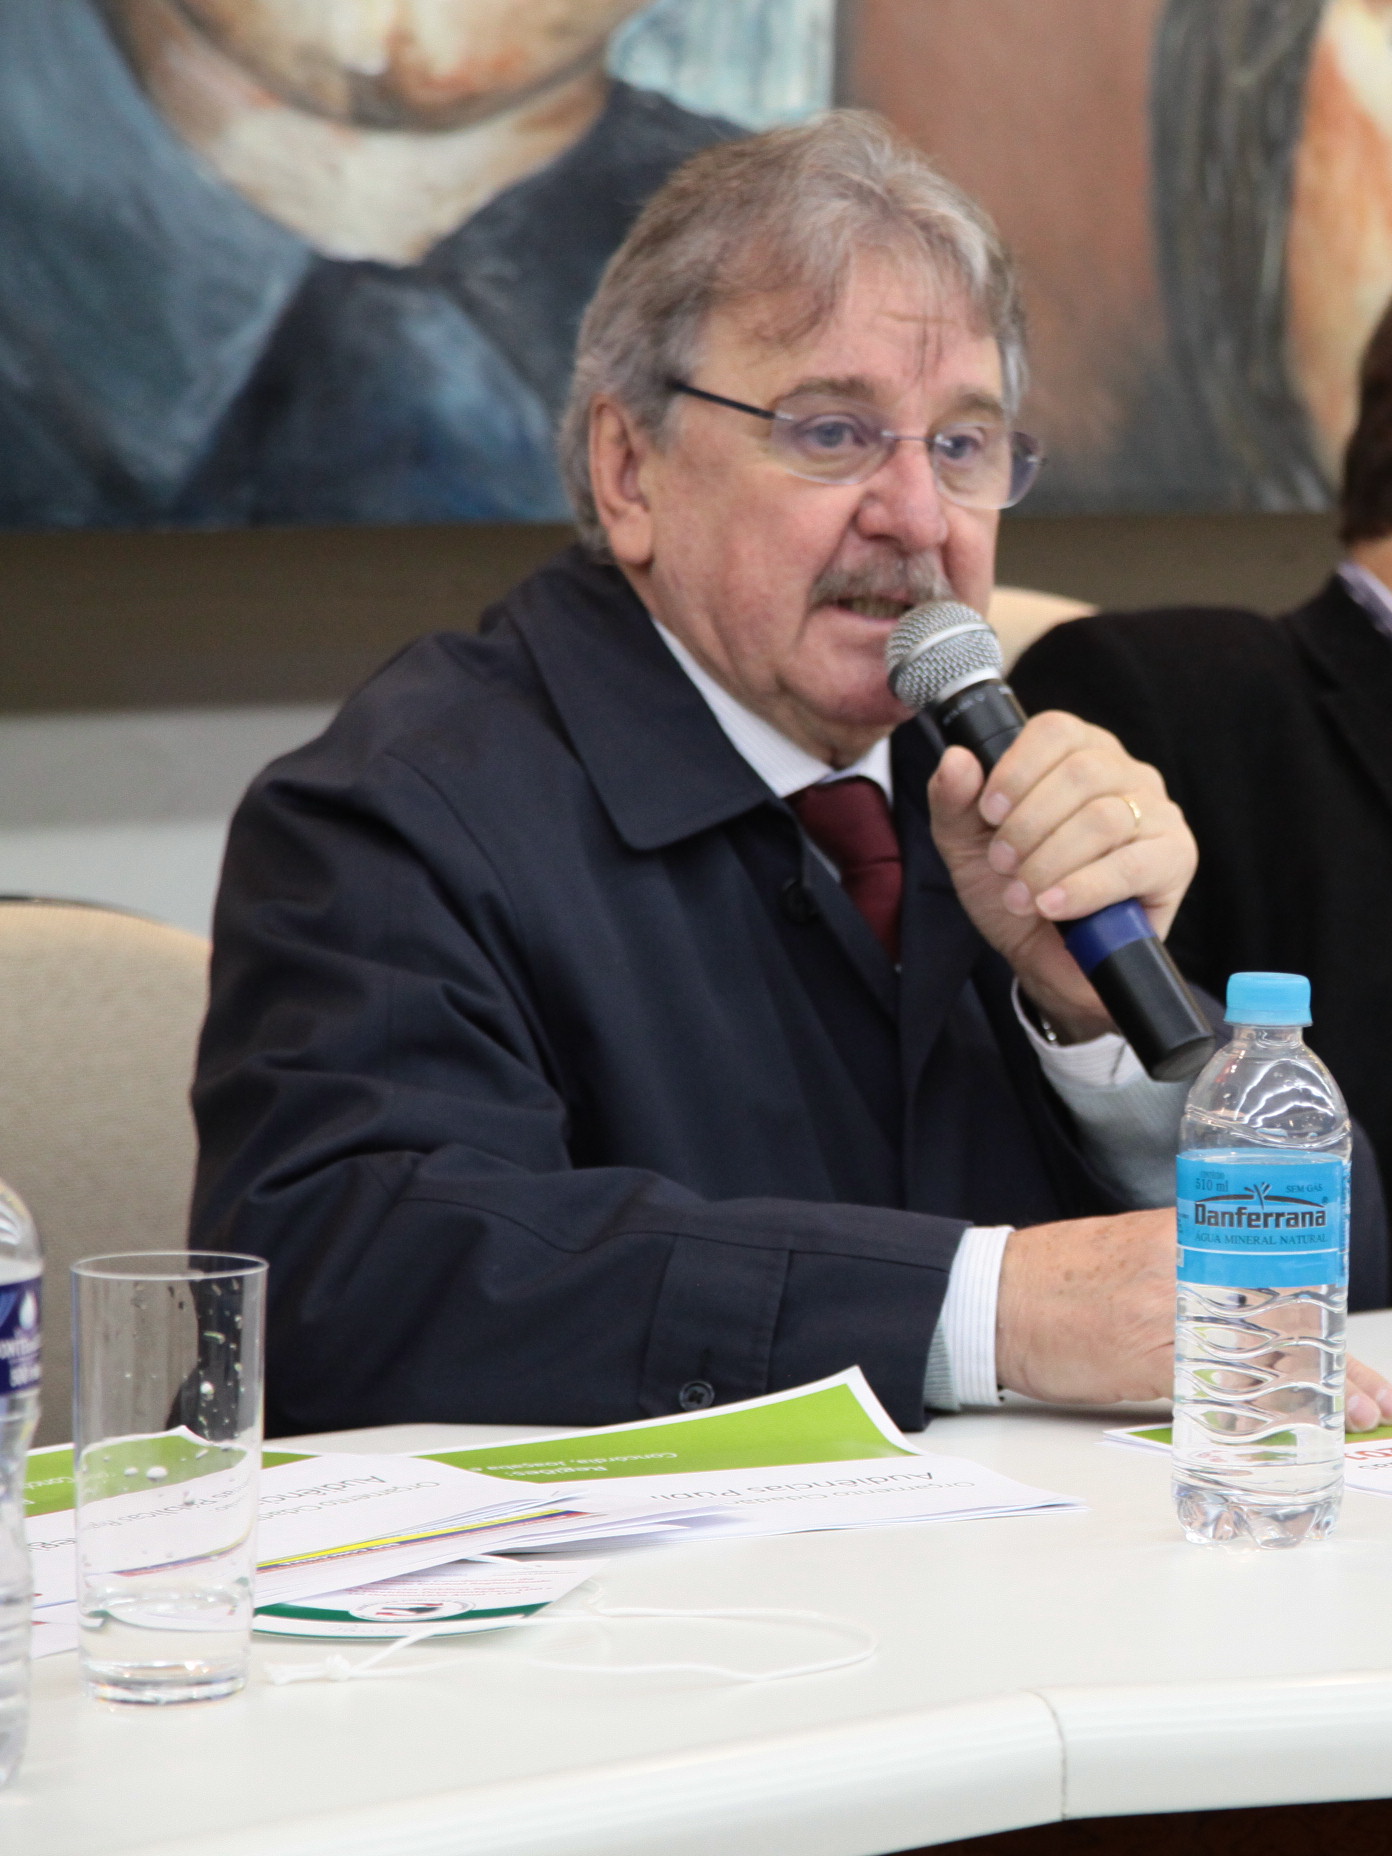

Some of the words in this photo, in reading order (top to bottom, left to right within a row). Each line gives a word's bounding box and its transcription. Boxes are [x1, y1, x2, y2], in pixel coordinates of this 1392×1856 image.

[1195, 1177, 1213, 1191] 510
[1216, 1180, 1229, 1192] ml
[1285, 1184, 1305, 1193] SEM
[1194, 1203, 1327, 1230] Danferrana
[1224, 1234, 1277, 1245] MINERAL
[1279, 1233, 1328, 1245] NATURAL
[746, 1471, 934, 1494] Audiências
[832, 1481, 976, 1498] Orçamento
[318, 1480, 441, 1508] Orçamento
